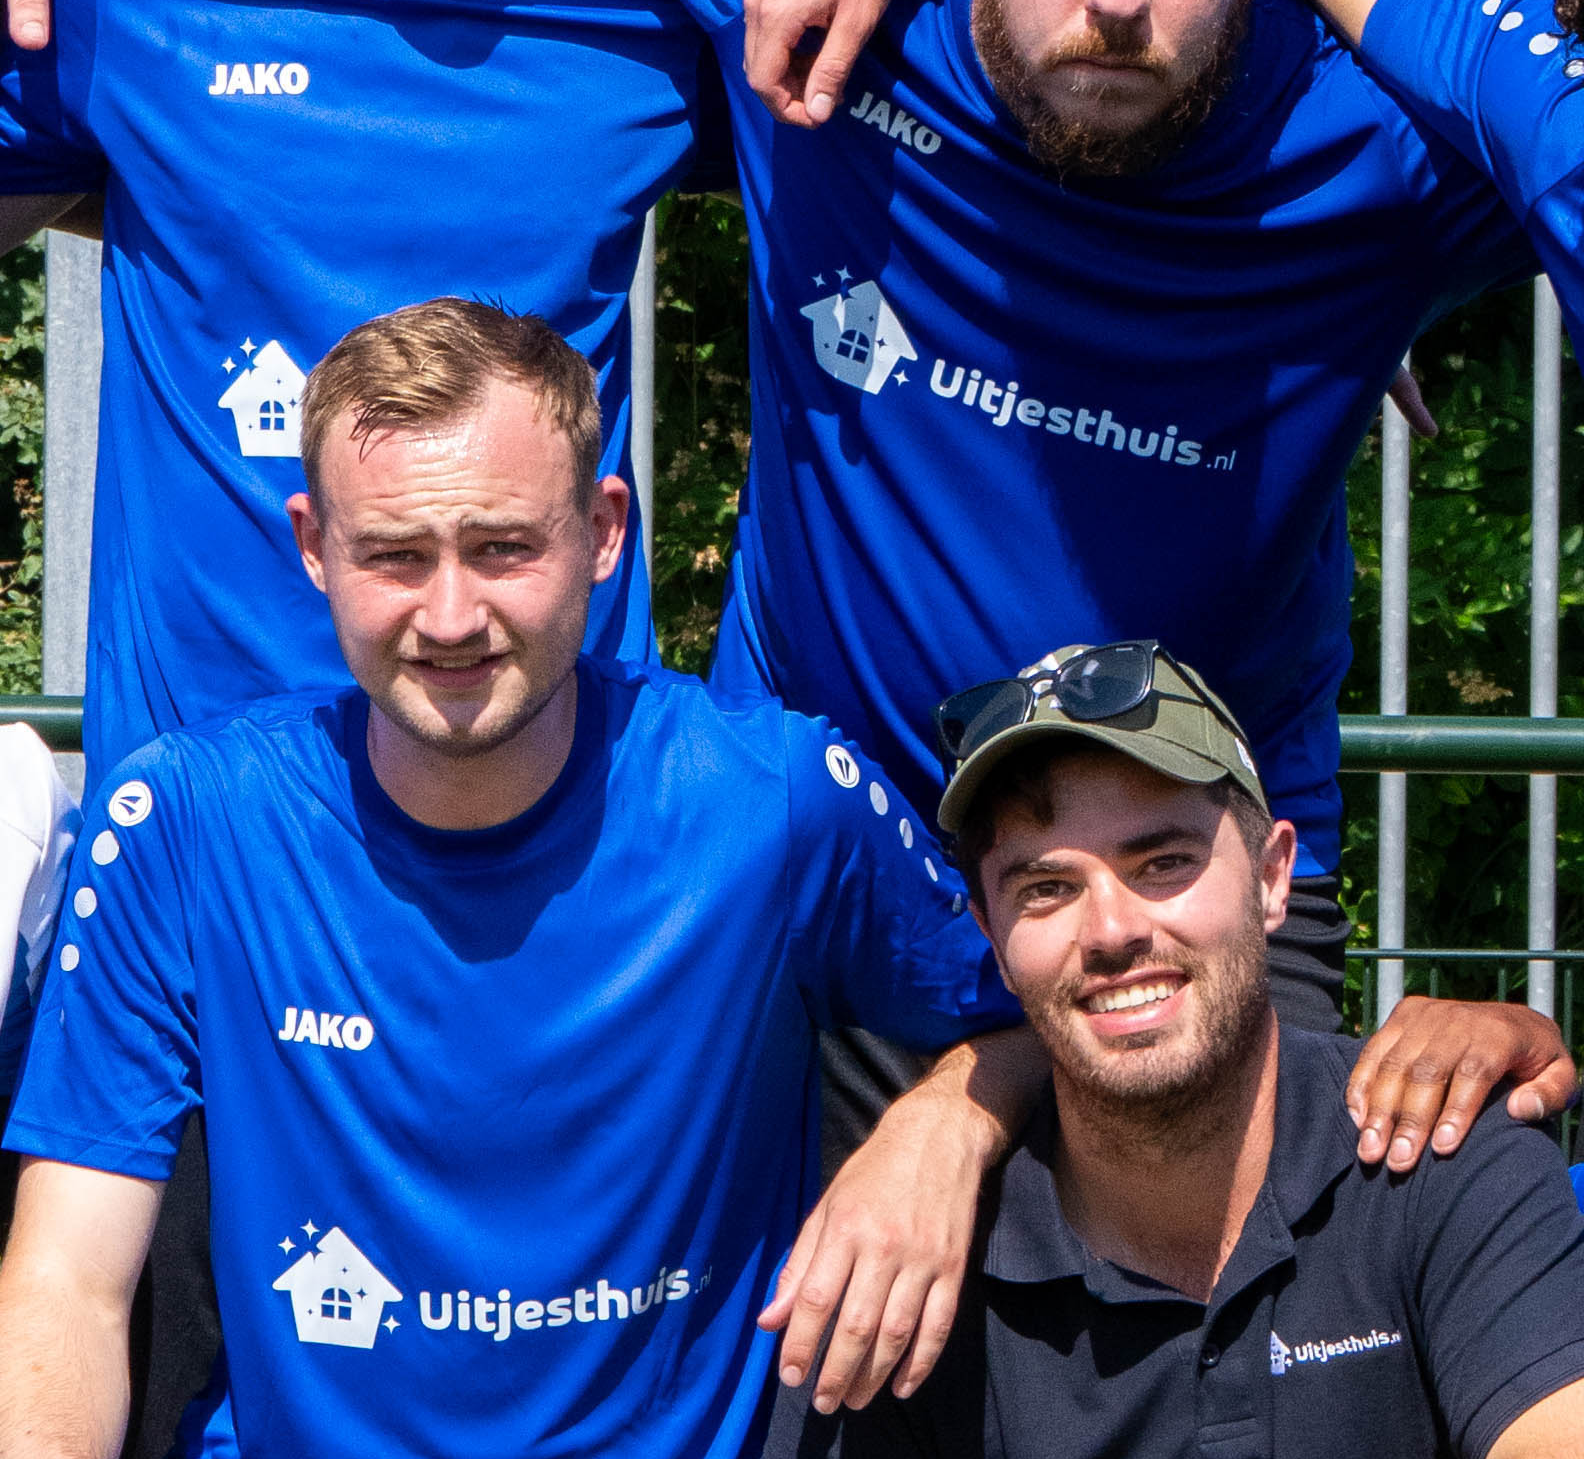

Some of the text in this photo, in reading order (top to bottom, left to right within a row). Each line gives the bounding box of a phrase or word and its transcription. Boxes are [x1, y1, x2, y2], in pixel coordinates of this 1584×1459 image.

[208, 62, 310, 96] JAKO
[849, 91, 942, 155] JAKO
[929, 358, 1236, 472] Uitjesthuis.nl
[277, 1006, 375, 1052] JAKO
